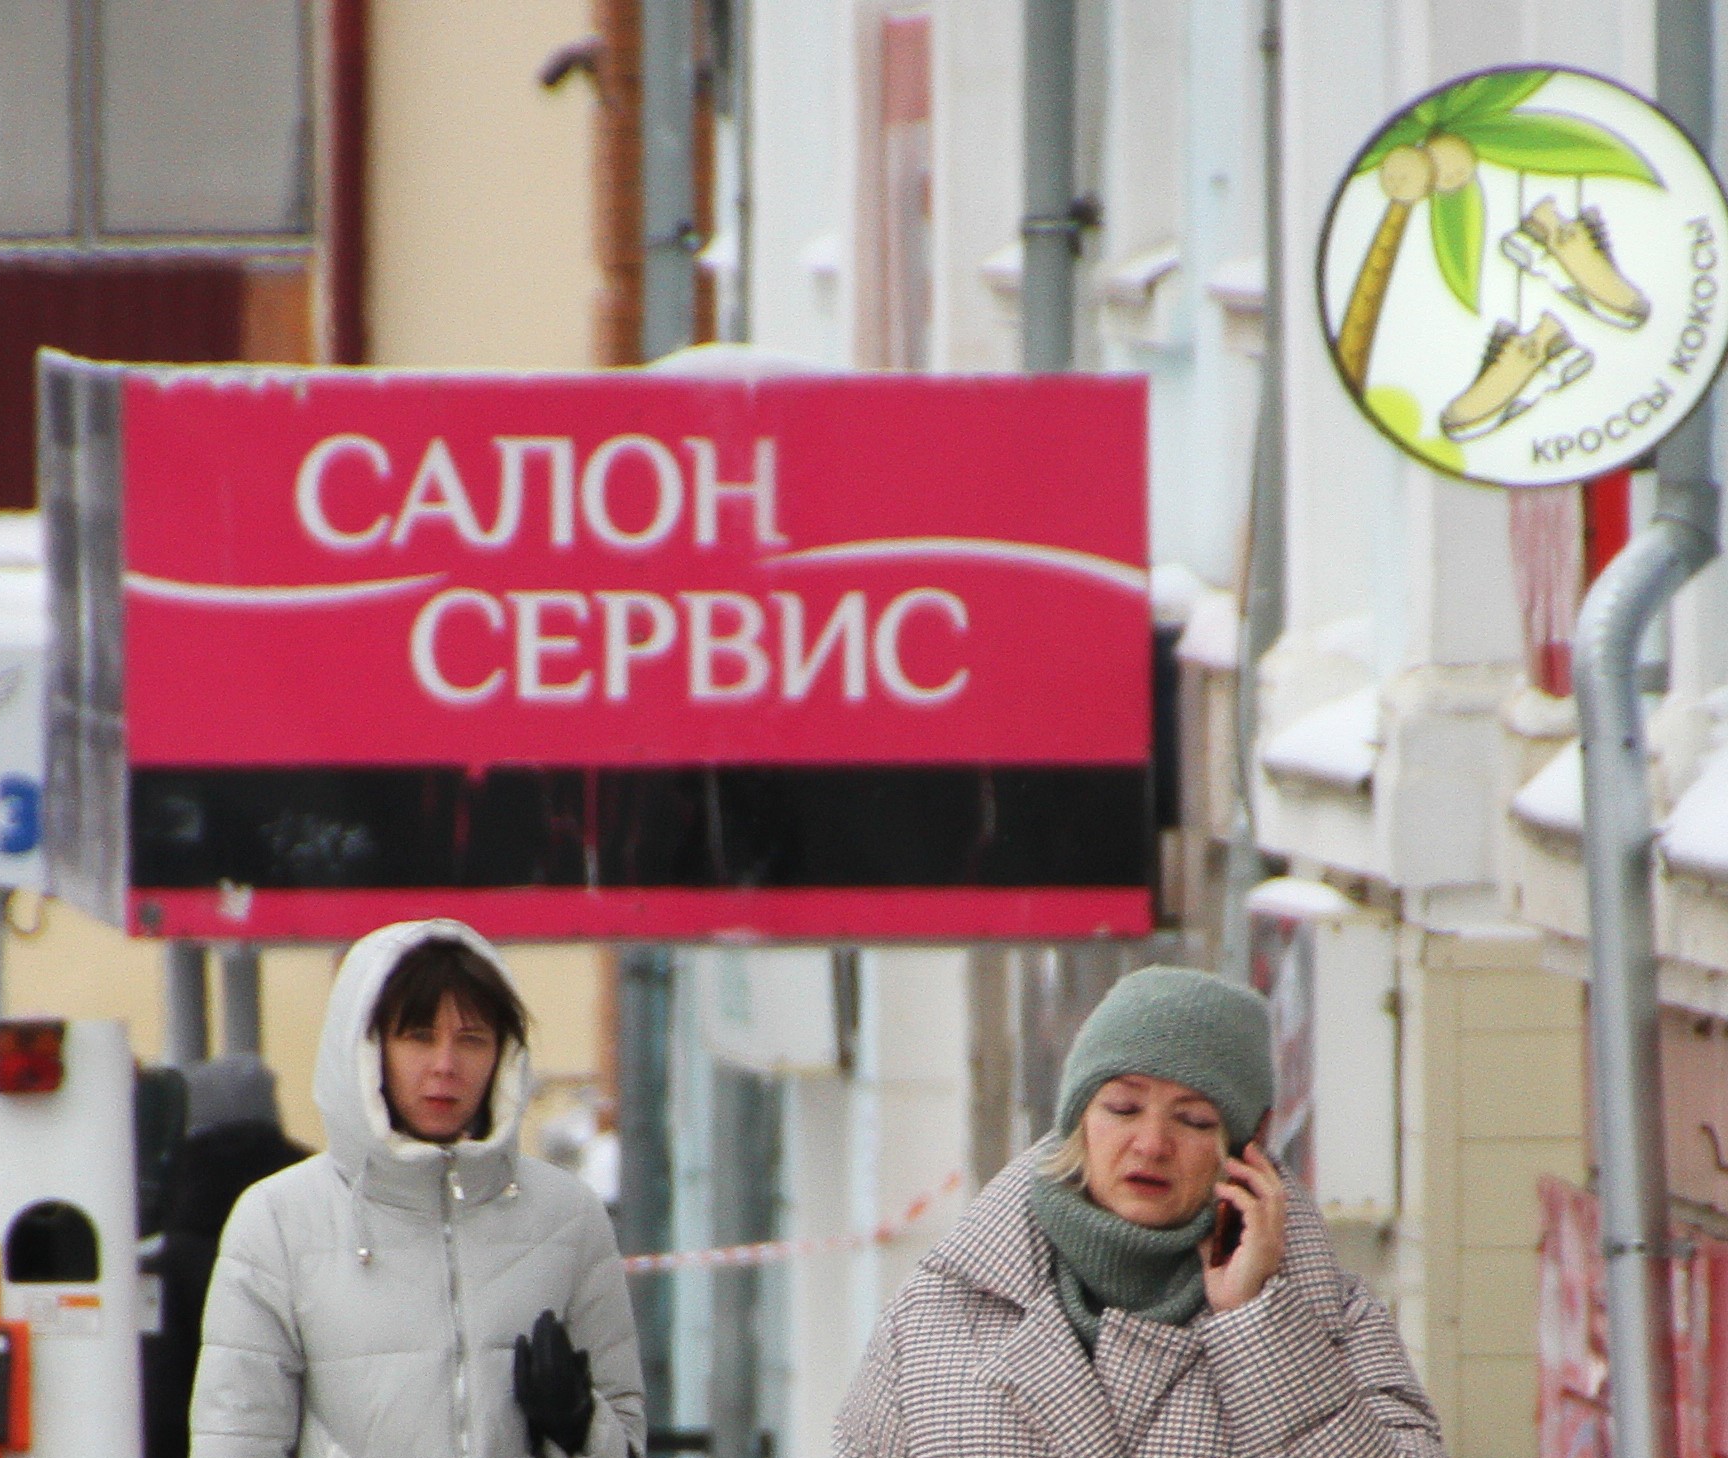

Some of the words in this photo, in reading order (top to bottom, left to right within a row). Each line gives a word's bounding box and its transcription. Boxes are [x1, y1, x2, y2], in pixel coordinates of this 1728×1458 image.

[1531, 378, 1675, 463] КРОССЫ
[1668, 214, 1719, 376] КОКОСЫ
[294, 432, 789, 549] САЛОН
[409, 587, 971, 705] СЕРВИС
